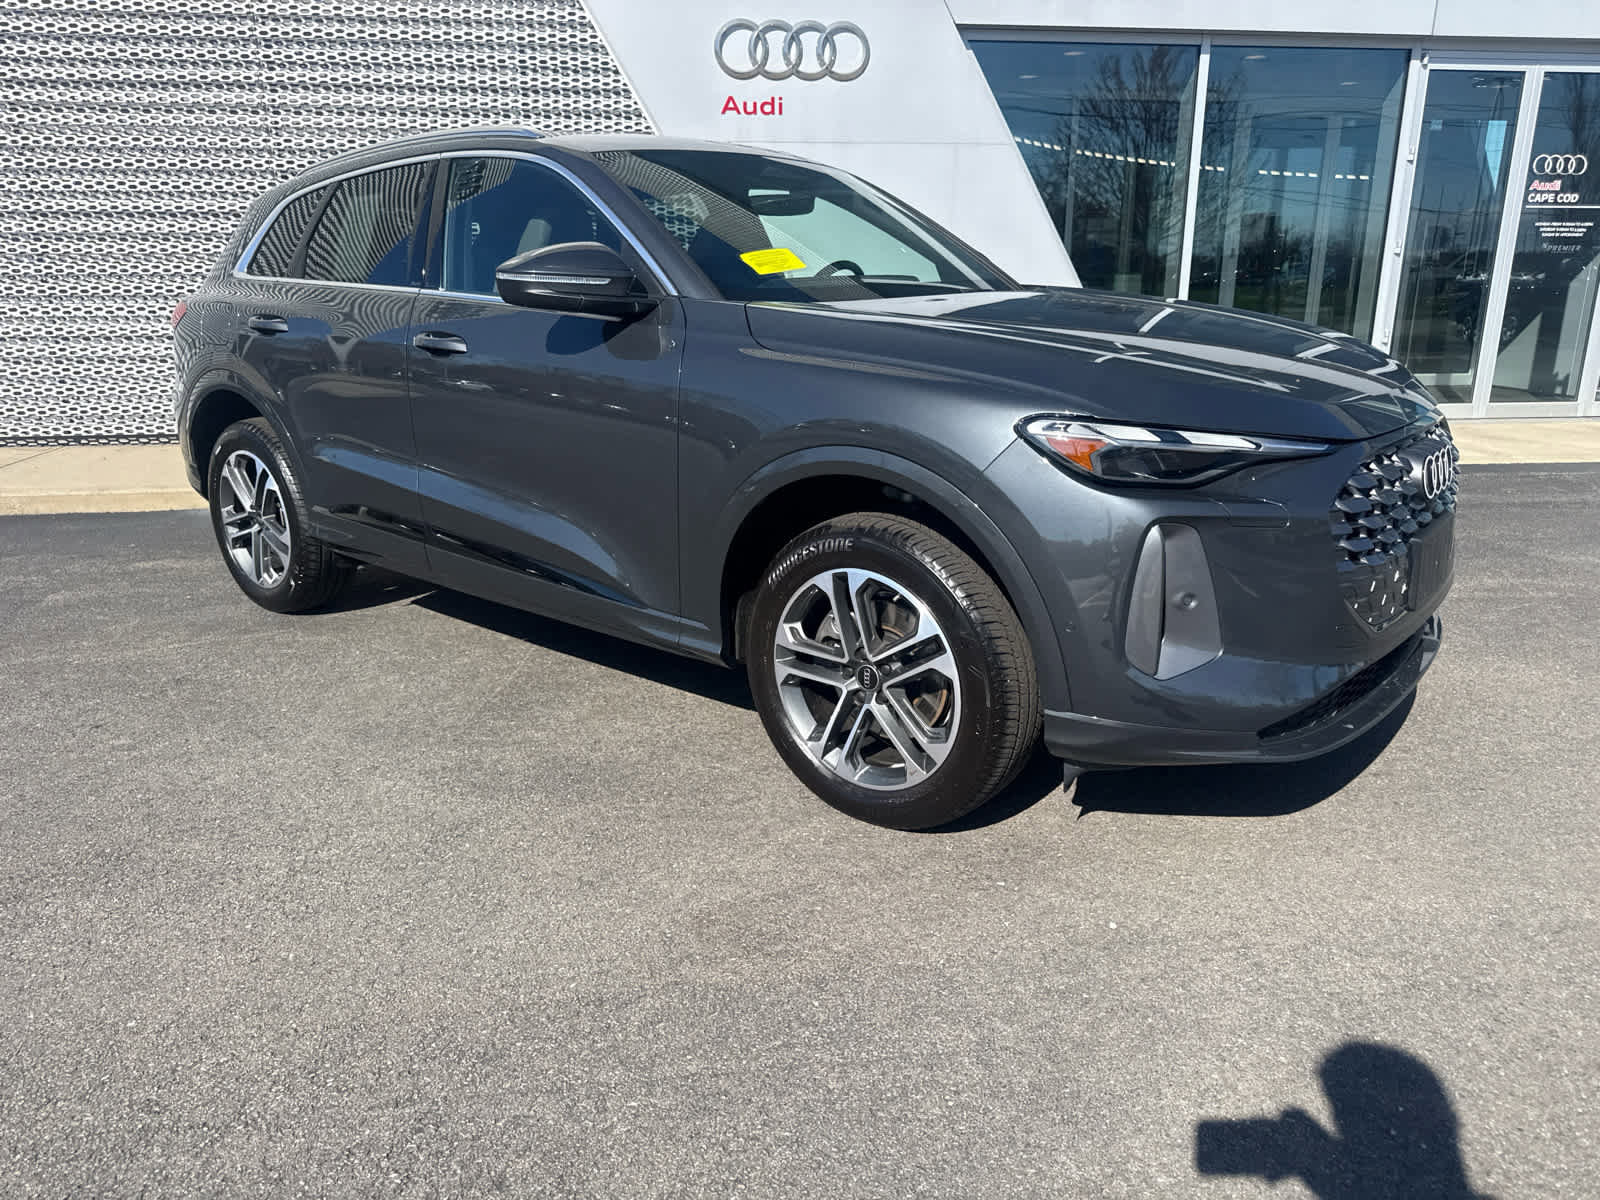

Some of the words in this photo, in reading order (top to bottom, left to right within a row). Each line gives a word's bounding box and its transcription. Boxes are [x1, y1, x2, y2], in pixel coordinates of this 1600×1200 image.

[721, 95, 783, 115] Audi
[1528, 180, 1561, 191] Audi
[1527, 193, 1555, 203] CAPE
[1557, 193, 1579, 203] COD
